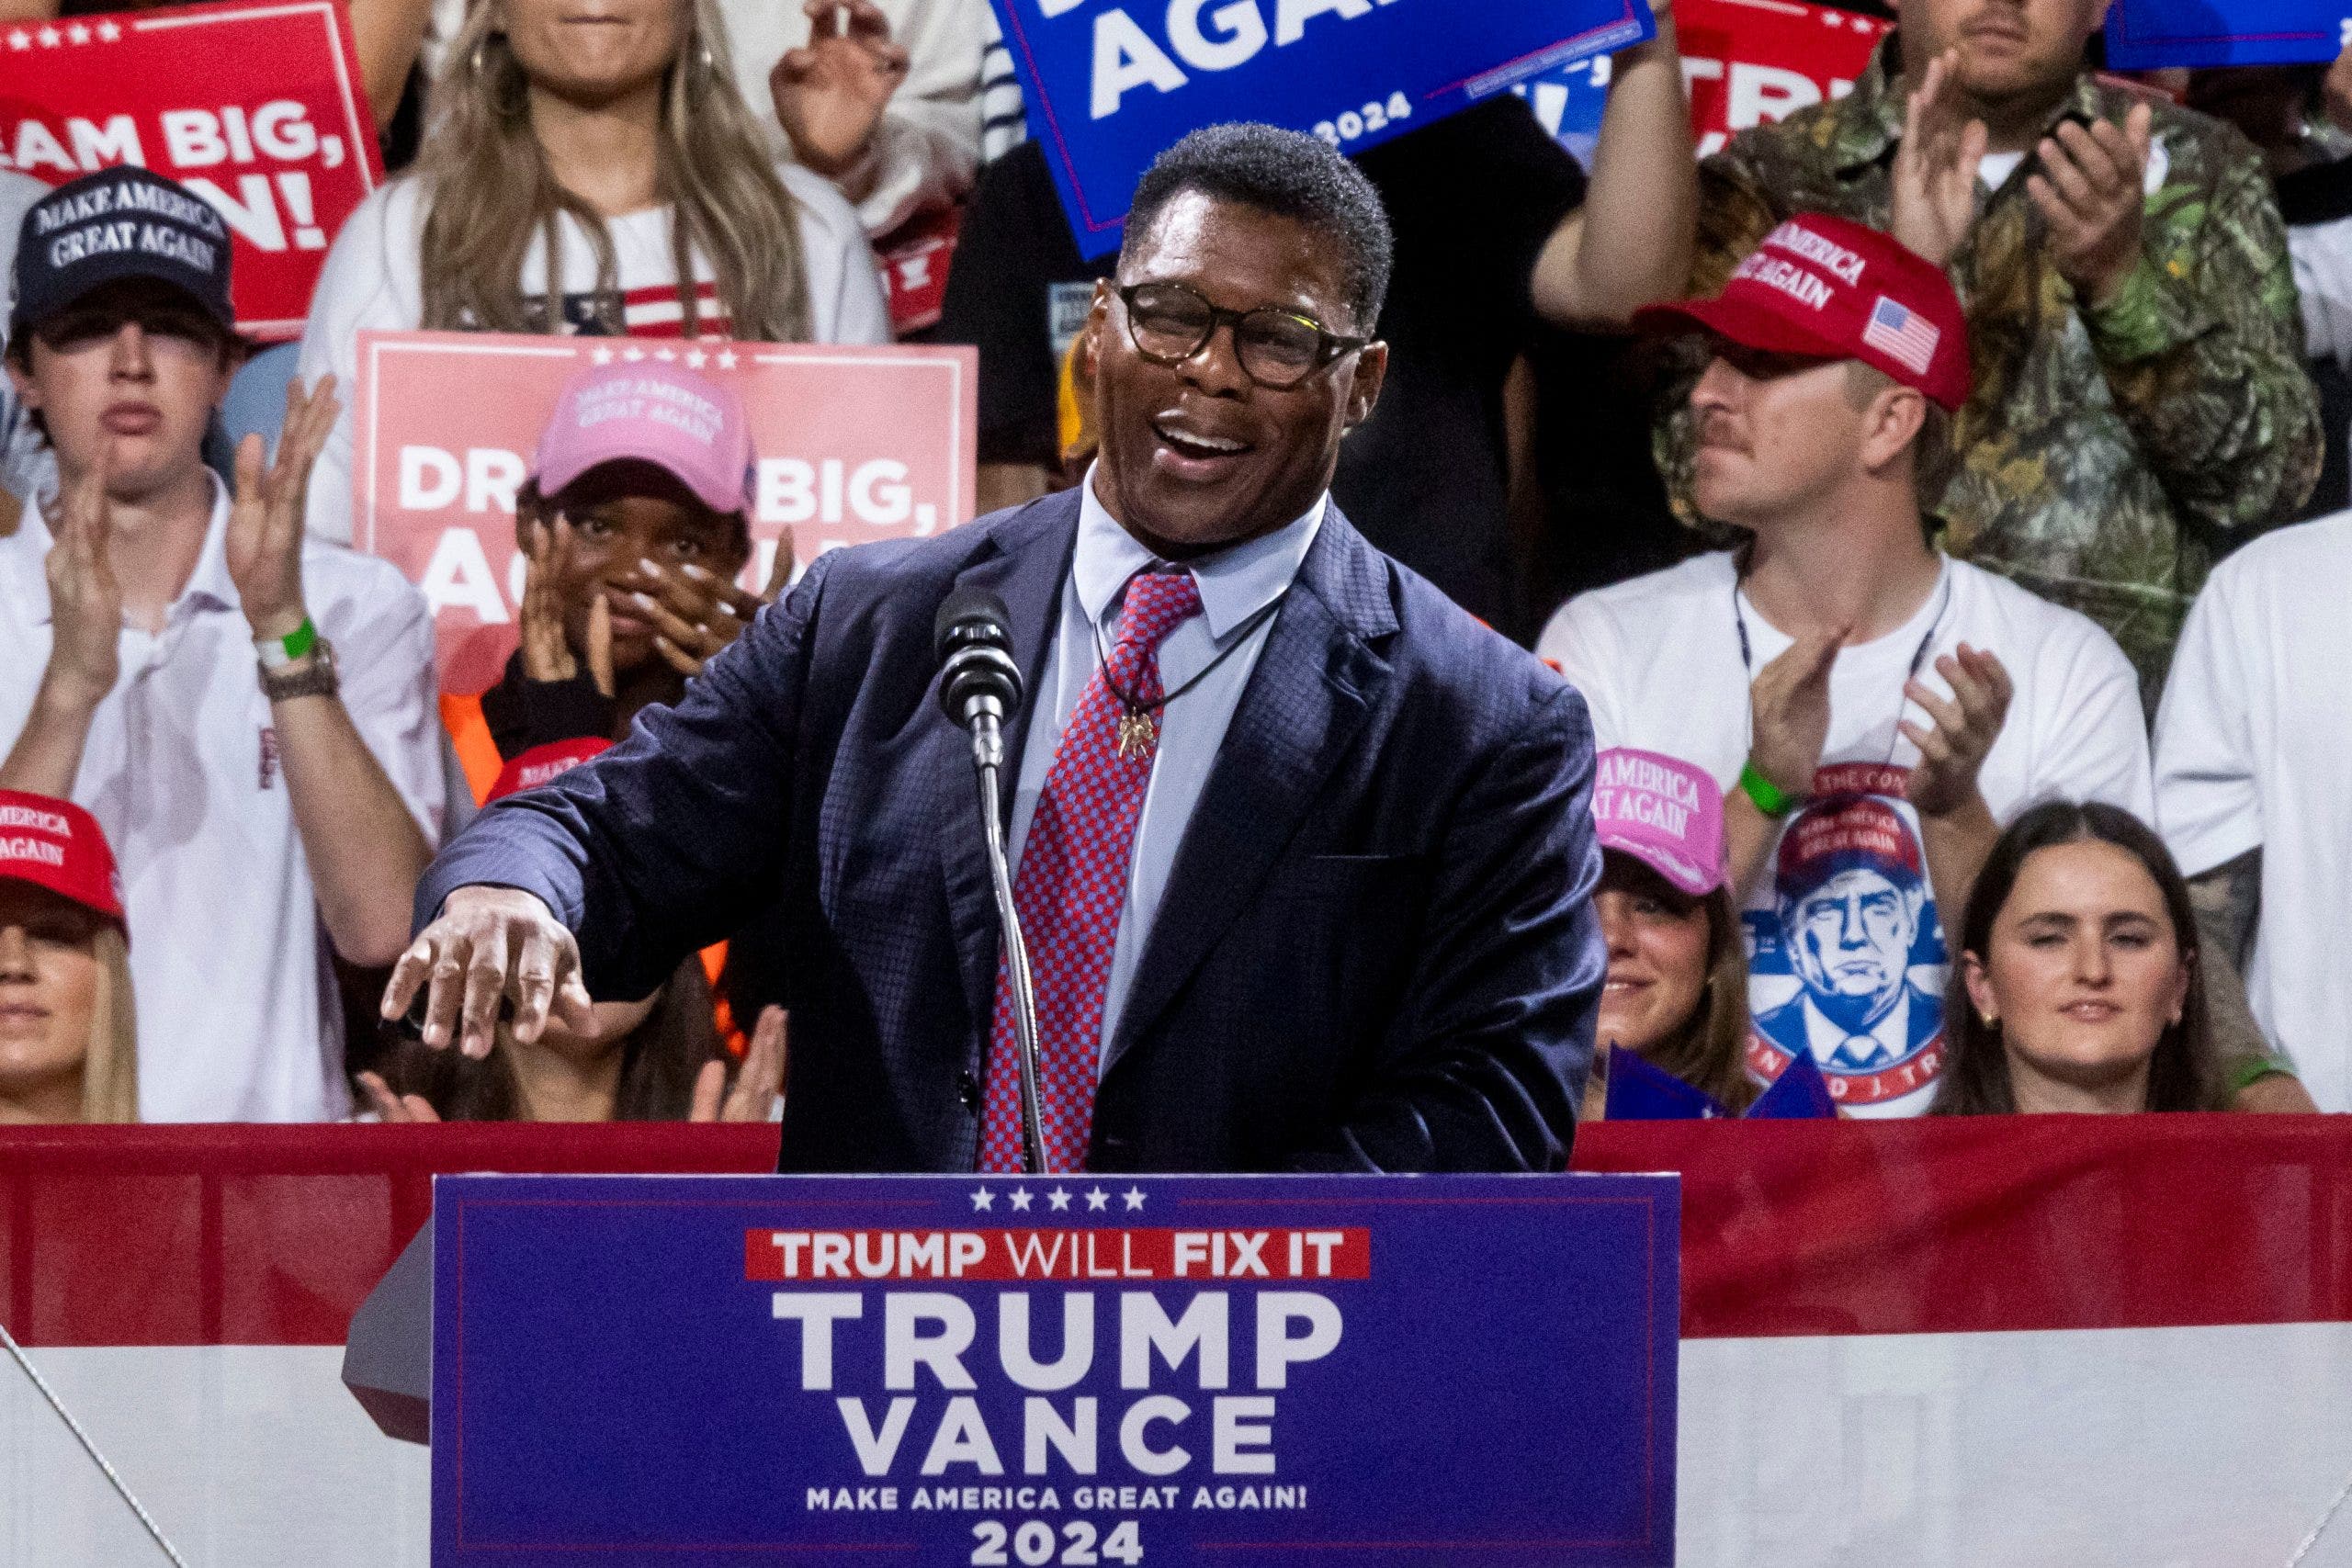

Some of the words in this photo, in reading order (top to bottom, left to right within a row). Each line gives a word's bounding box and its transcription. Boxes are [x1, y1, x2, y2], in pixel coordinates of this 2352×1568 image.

[0, 115, 147, 173] AM
[160, 99, 345, 169] BIG,
[1313, 91, 1412, 147] 2024
[37, 186, 113, 236] MAKE
[115, 180, 228, 242] AMERICA
[49, 221, 137, 268] GREAT
[140, 223, 216, 276] AGAIN
[758, 457, 938, 536] BIG,
[1599, 753, 1700, 814] AMERICA
[1616, 790, 1689, 840] AGAIN
[773, 1232, 987, 1278] TRUMP
[1004, 1232, 1153, 1278] WILL
[1173, 1232, 1270, 1277] FIX
[1288, 1232, 1344, 1277] IT
[772, 1291, 1344, 1392] TRUMP
[836, 1394, 1276, 1476] VANCE
[807, 1487, 898, 1510] MAKE
[910, 1486, 1060, 1510] AMERICA
[1073, 1485, 1180, 1509] GREAT
[1192, 1484, 1307, 1509] AGAIN!
[970, 1520, 1144, 1566] 2024
